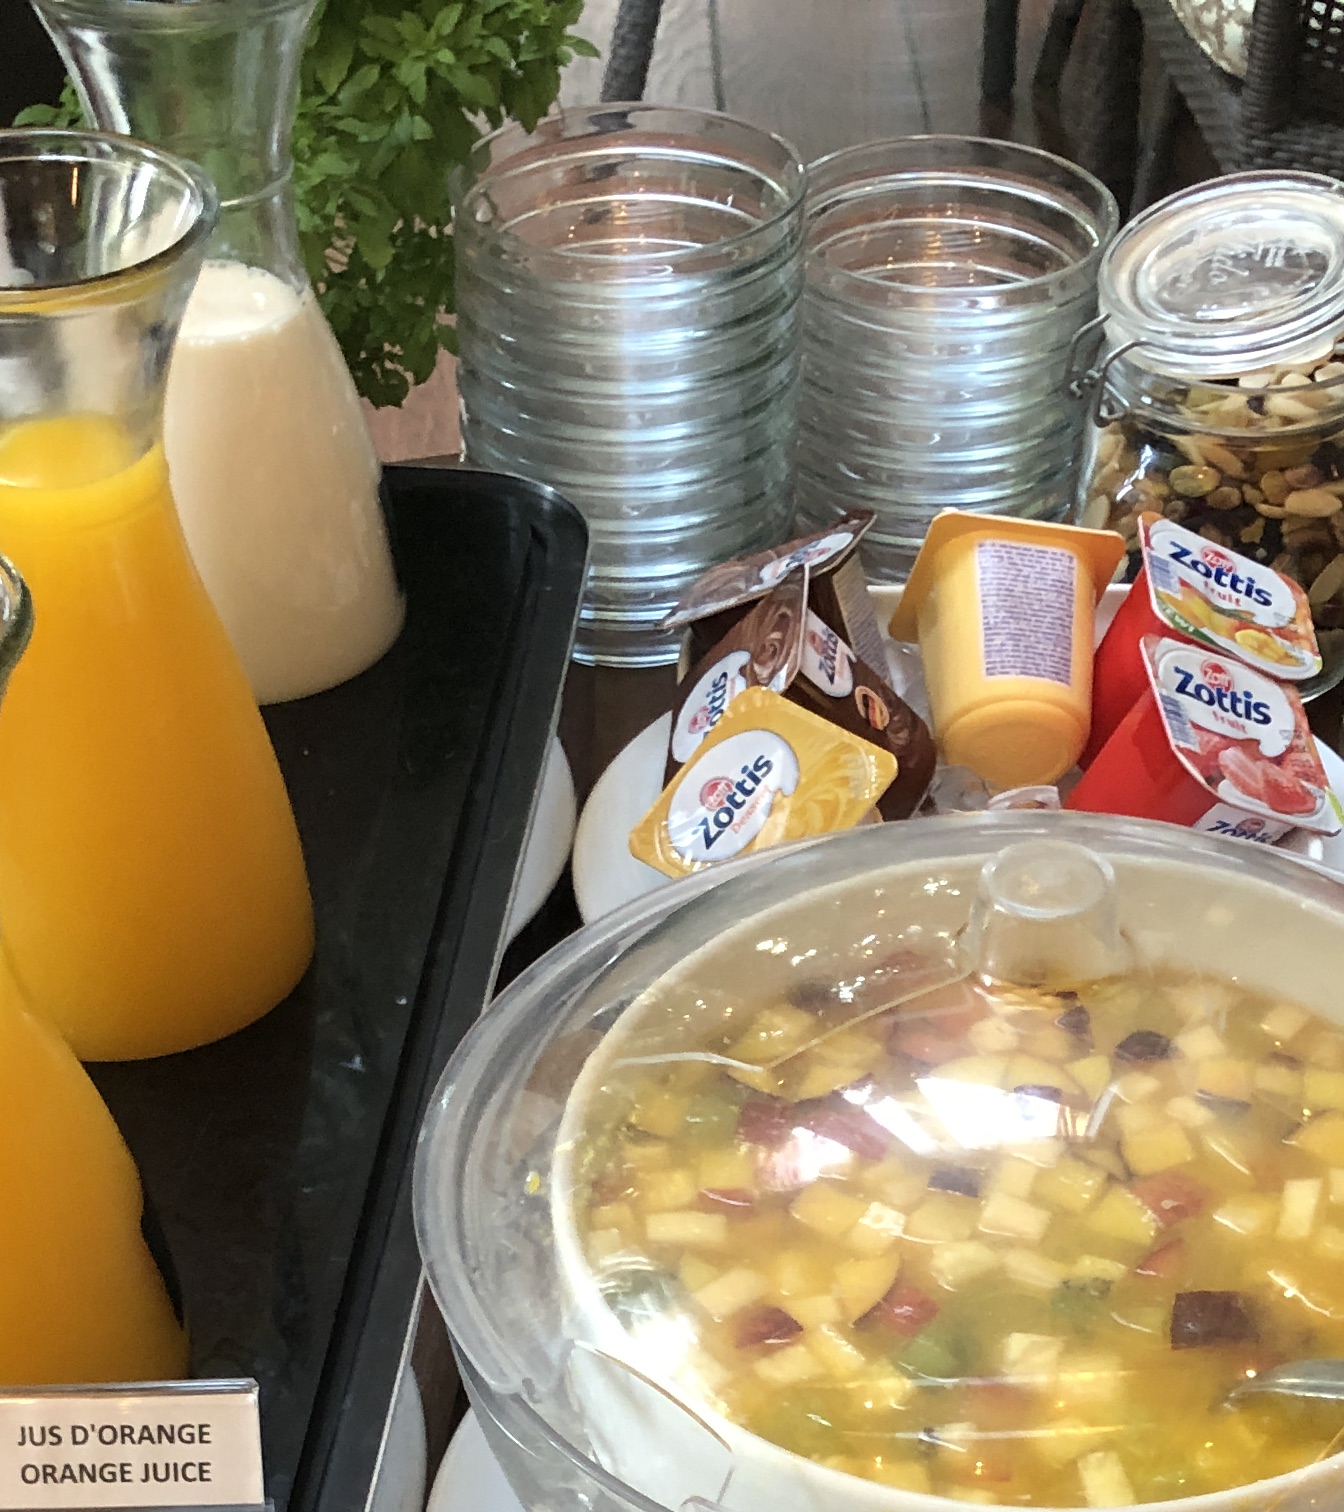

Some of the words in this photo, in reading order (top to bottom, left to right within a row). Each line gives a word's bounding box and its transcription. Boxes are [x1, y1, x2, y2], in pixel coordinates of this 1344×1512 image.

[1169, 540, 1273, 607] Zottis
[703, 671, 728, 737] ottis
[1173, 665, 1272, 726] Zottis
[690, 754, 774, 851] Zottis
[17, 1424, 63, 1448] JUS
[72, 1423, 213, 1447] D'ORANGE
[20, 1462, 133, 1486] ORANGE
[139, 1461, 213, 1485] JUICE
